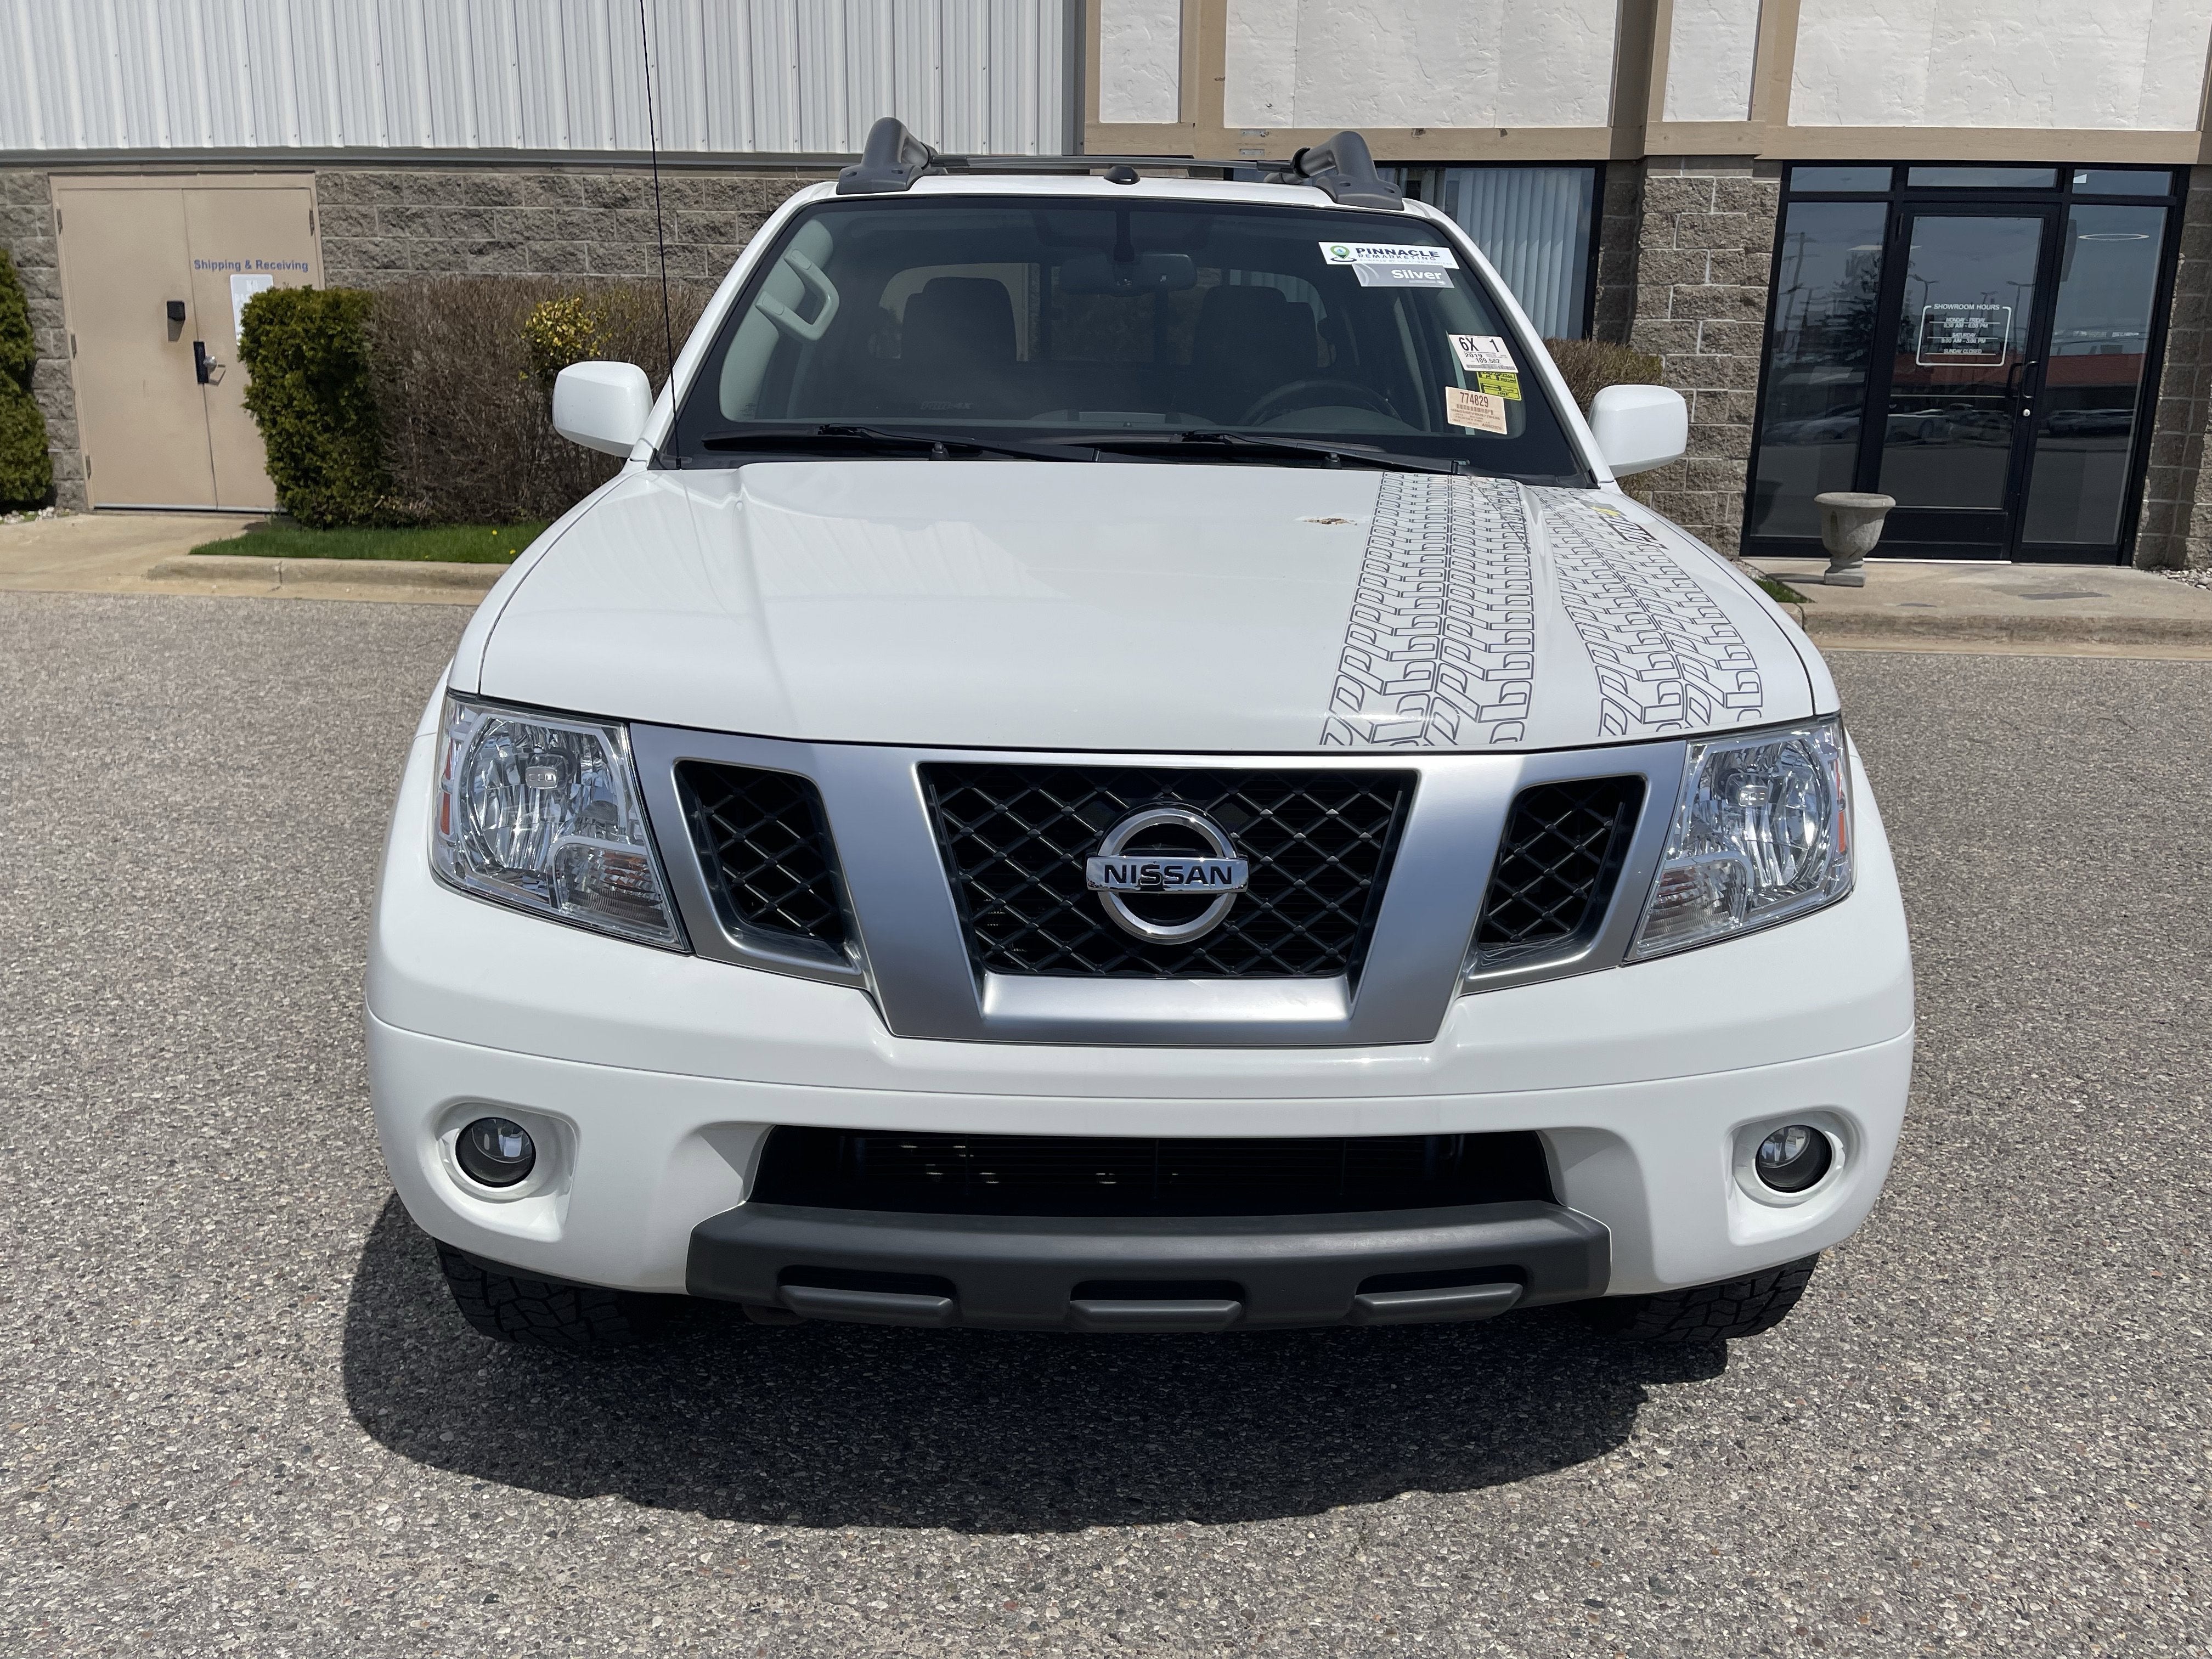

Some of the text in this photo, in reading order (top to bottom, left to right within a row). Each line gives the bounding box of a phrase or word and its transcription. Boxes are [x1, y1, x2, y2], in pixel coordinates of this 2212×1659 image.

[1355, 247, 1440, 257] PINNACLE
[194, 259, 308, 272] Shipping & Receiving
[1391, 269, 1442, 280] Silver
[1459, 337, 1499, 352] 6X 1
[1460, 392, 1489, 408] 774829
[1104, 864, 1233, 886] NISSAN
